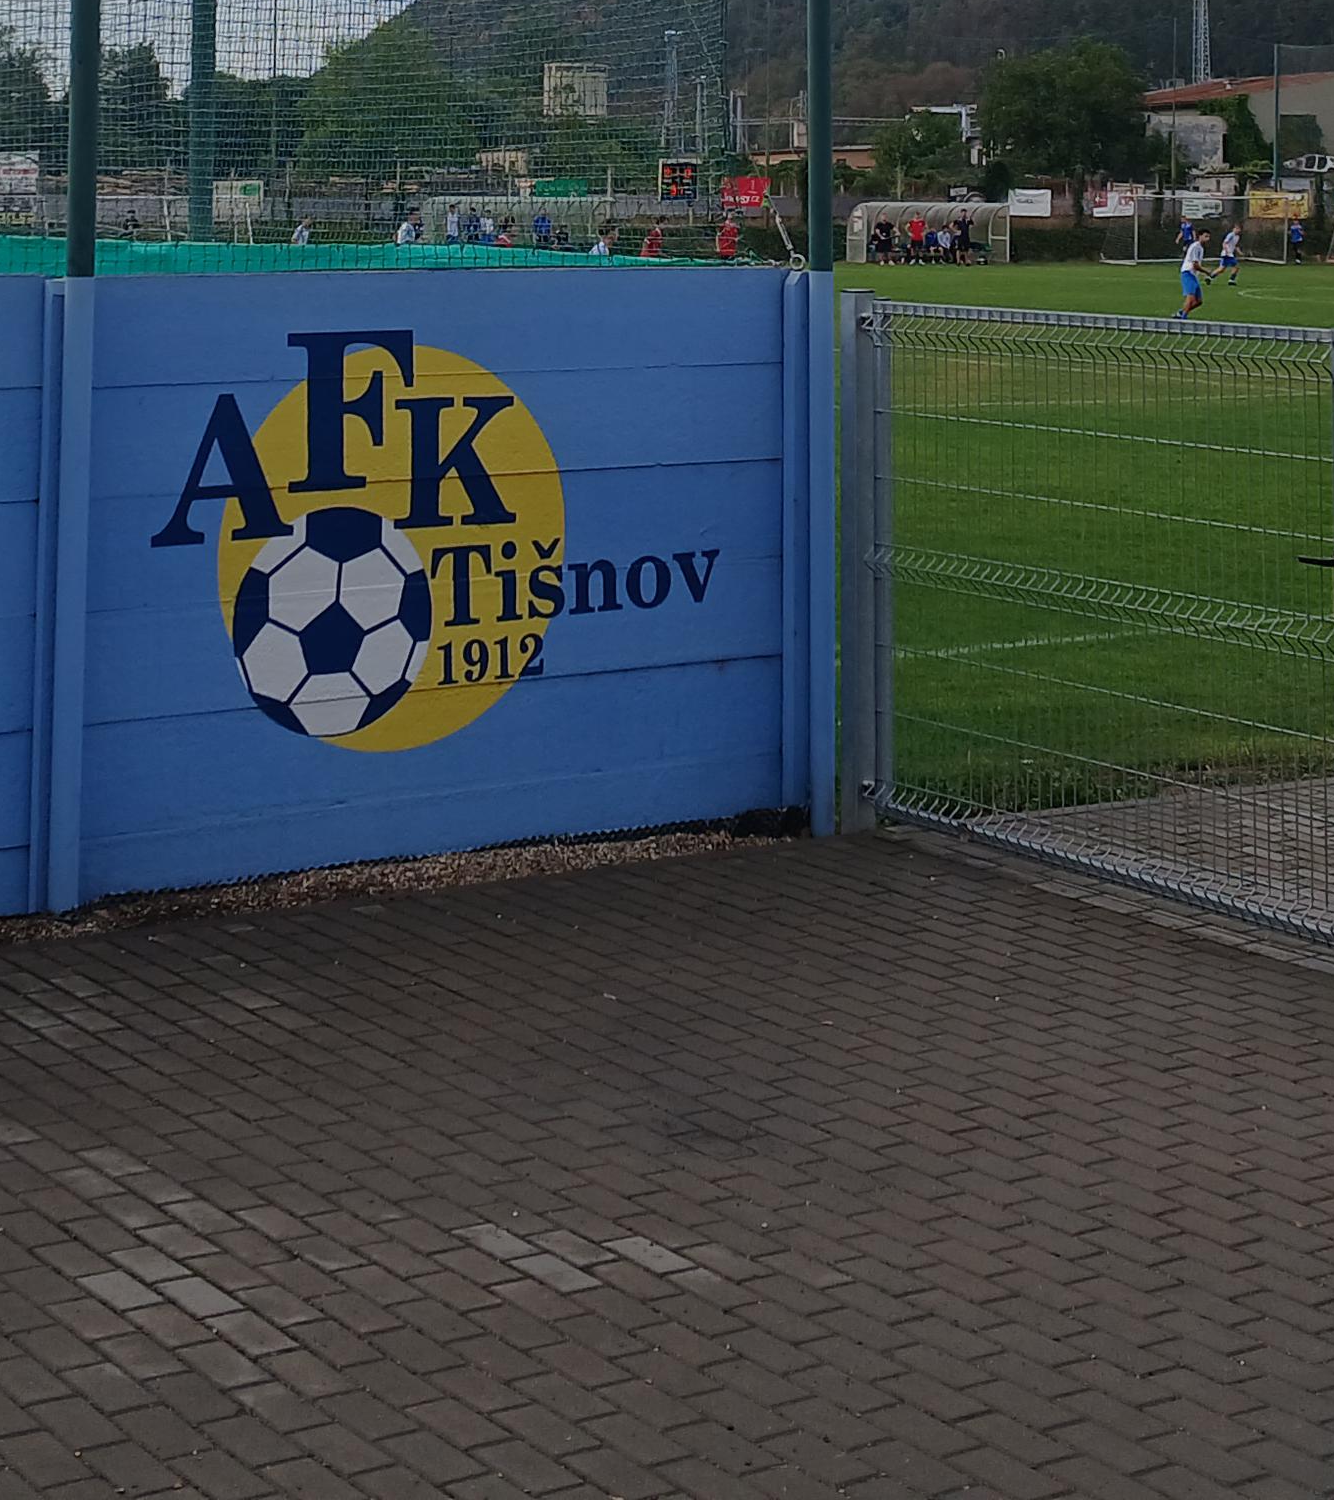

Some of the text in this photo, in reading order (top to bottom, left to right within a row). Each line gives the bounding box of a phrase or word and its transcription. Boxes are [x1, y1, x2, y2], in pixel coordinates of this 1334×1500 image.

[151, 329, 516, 547] AFK
[431, 537, 720, 626] Tišnov
[437, 633, 544, 685] 1912
